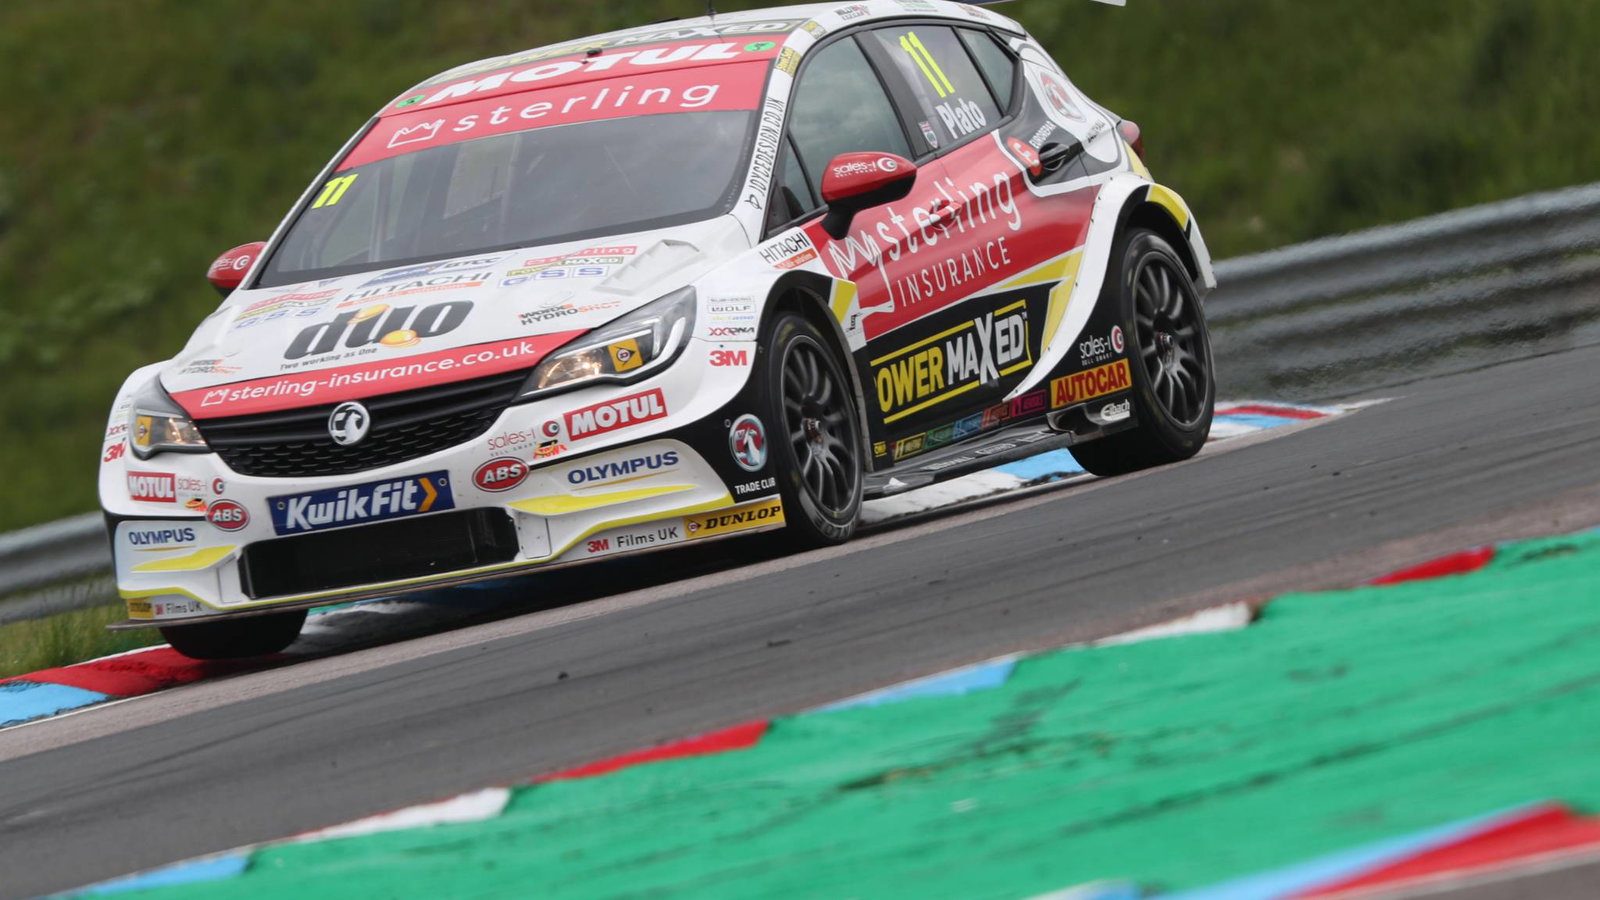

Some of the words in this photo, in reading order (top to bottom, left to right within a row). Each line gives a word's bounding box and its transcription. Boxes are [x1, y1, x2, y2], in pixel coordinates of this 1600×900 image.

[419, 42, 743, 105] MOTUL
[899, 31, 955, 98] 11
[453, 84, 719, 132] sterling
[935, 98, 986, 139] Plato
[311, 173, 359, 210] 11
[759, 232, 811, 264] HITACHI
[344, 272, 492, 301] HITACHI
[897, 237, 1011, 307] INSURANCE
[283, 300, 475, 360] duo
[229, 342, 535, 401] sterling-insurance.co.uk
[302, 353, 341, 369] working
[709, 350, 747, 366] 3M
[873, 347, 945, 413] OWER
[1055, 362, 1128, 406] AUTOCAR
[570, 393, 664, 436] MOTUL
[482, 464, 522, 484] ABS
[567, 451, 679, 484] OLYMPUS
[128, 476, 175, 498] MOTUL
[734, 481, 761, 495] TRADE
[761, 477, 776, 489] CLUB
[212, 508, 243, 522] ABS
[703, 505, 781, 530] DUNLOP
[128, 528, 196, 546] OLYMPUS
[587, 538, 609, 553] 3M
[616, 533, 655, 548] Films
[658, 527, 679, 541] UK
